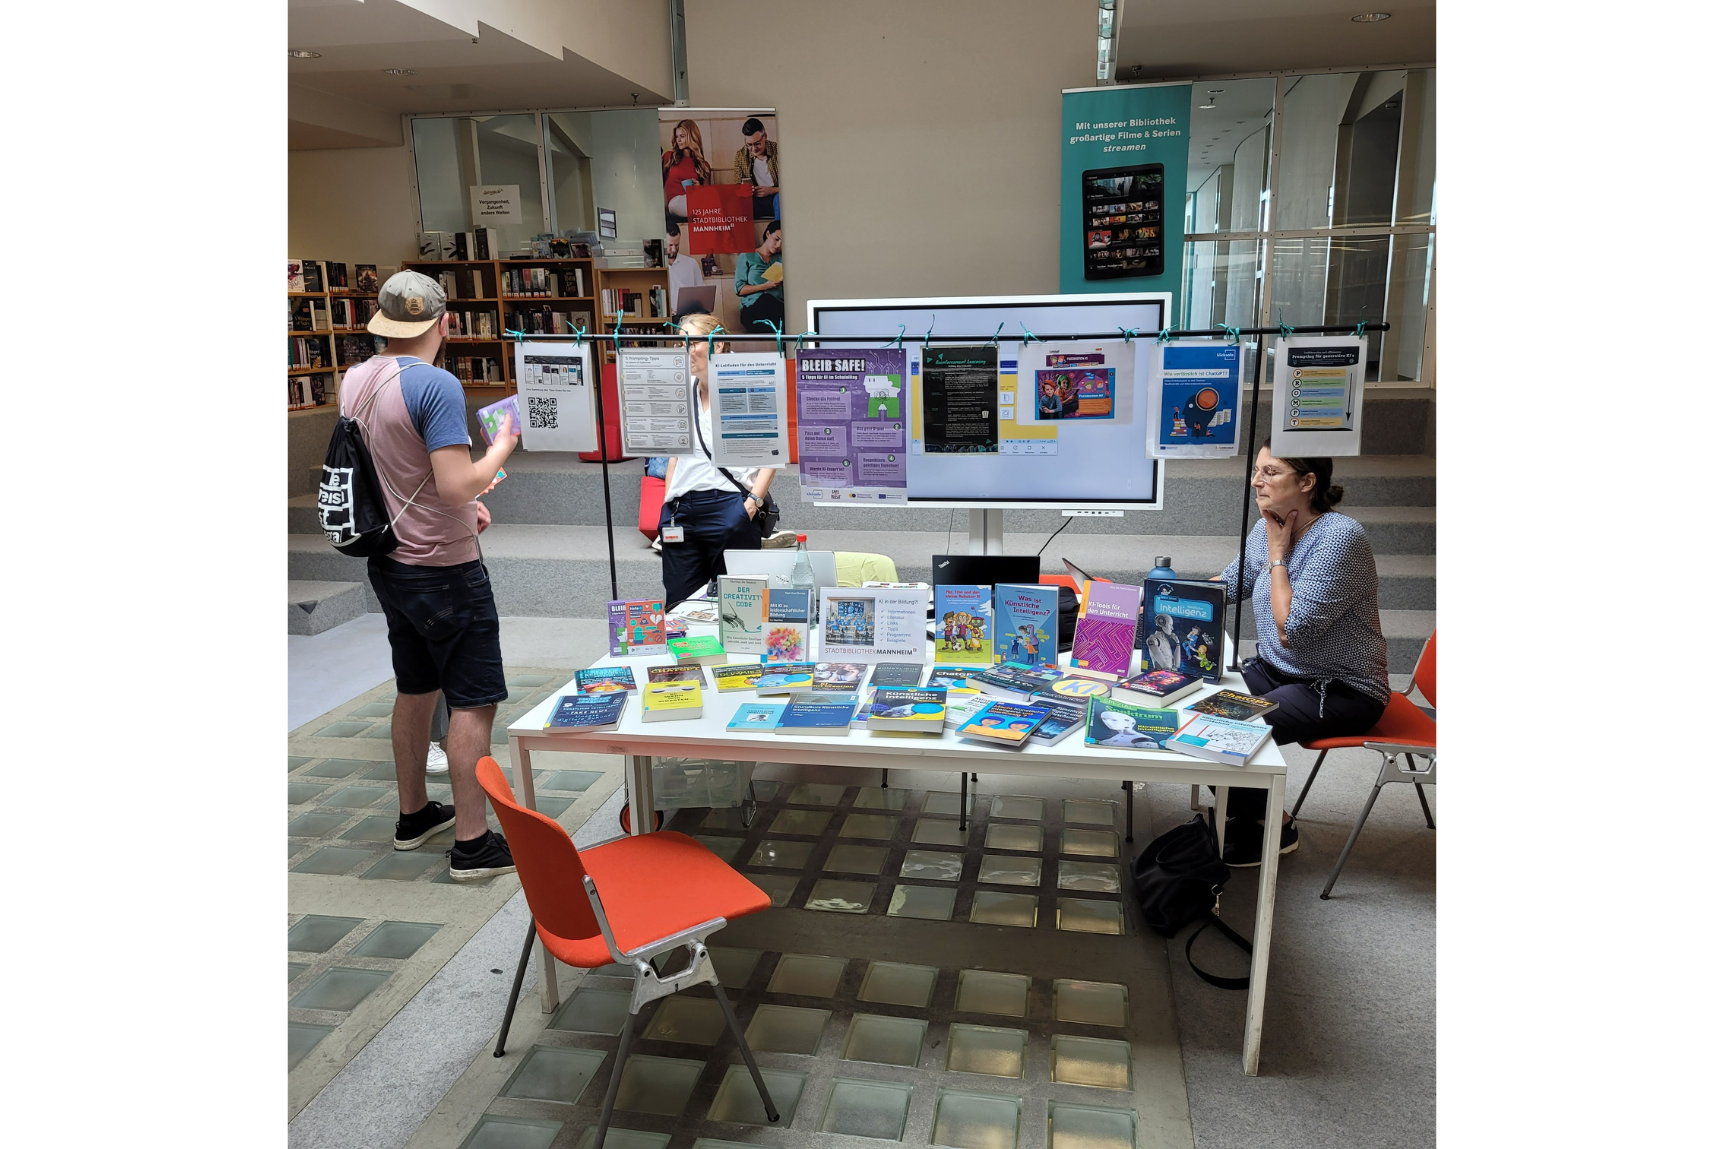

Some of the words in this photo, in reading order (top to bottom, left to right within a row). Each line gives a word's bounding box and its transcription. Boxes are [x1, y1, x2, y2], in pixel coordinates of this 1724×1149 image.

[1093, 121, 1127, 129] unserer
[1130, 117, 1176, 127] Bibliothek
[1070, 133, 1116, 144] großartige
[1152, 130, 1181, 138] Serien
[1103, 144, 1146, 152] streamen
[802, 360, 833, 372] BLEIB
[835, 360, 865, 371] SAFE!
[1005, 600, 1040, 609] Künstliche
[1088, 601, 1110, 609] KI-Tools
[1013, 607, 1050, 616] Intelligenz?
[1100, 610, 1128, 618] Unterricht
[1160, 604, 1206, 617] Intelligenz
[1060, 681, 1100, 694] KI
[1104, 699, 1132, 710] SPEZIAL
[1220, 692, 1273, 706] ChatGPT
